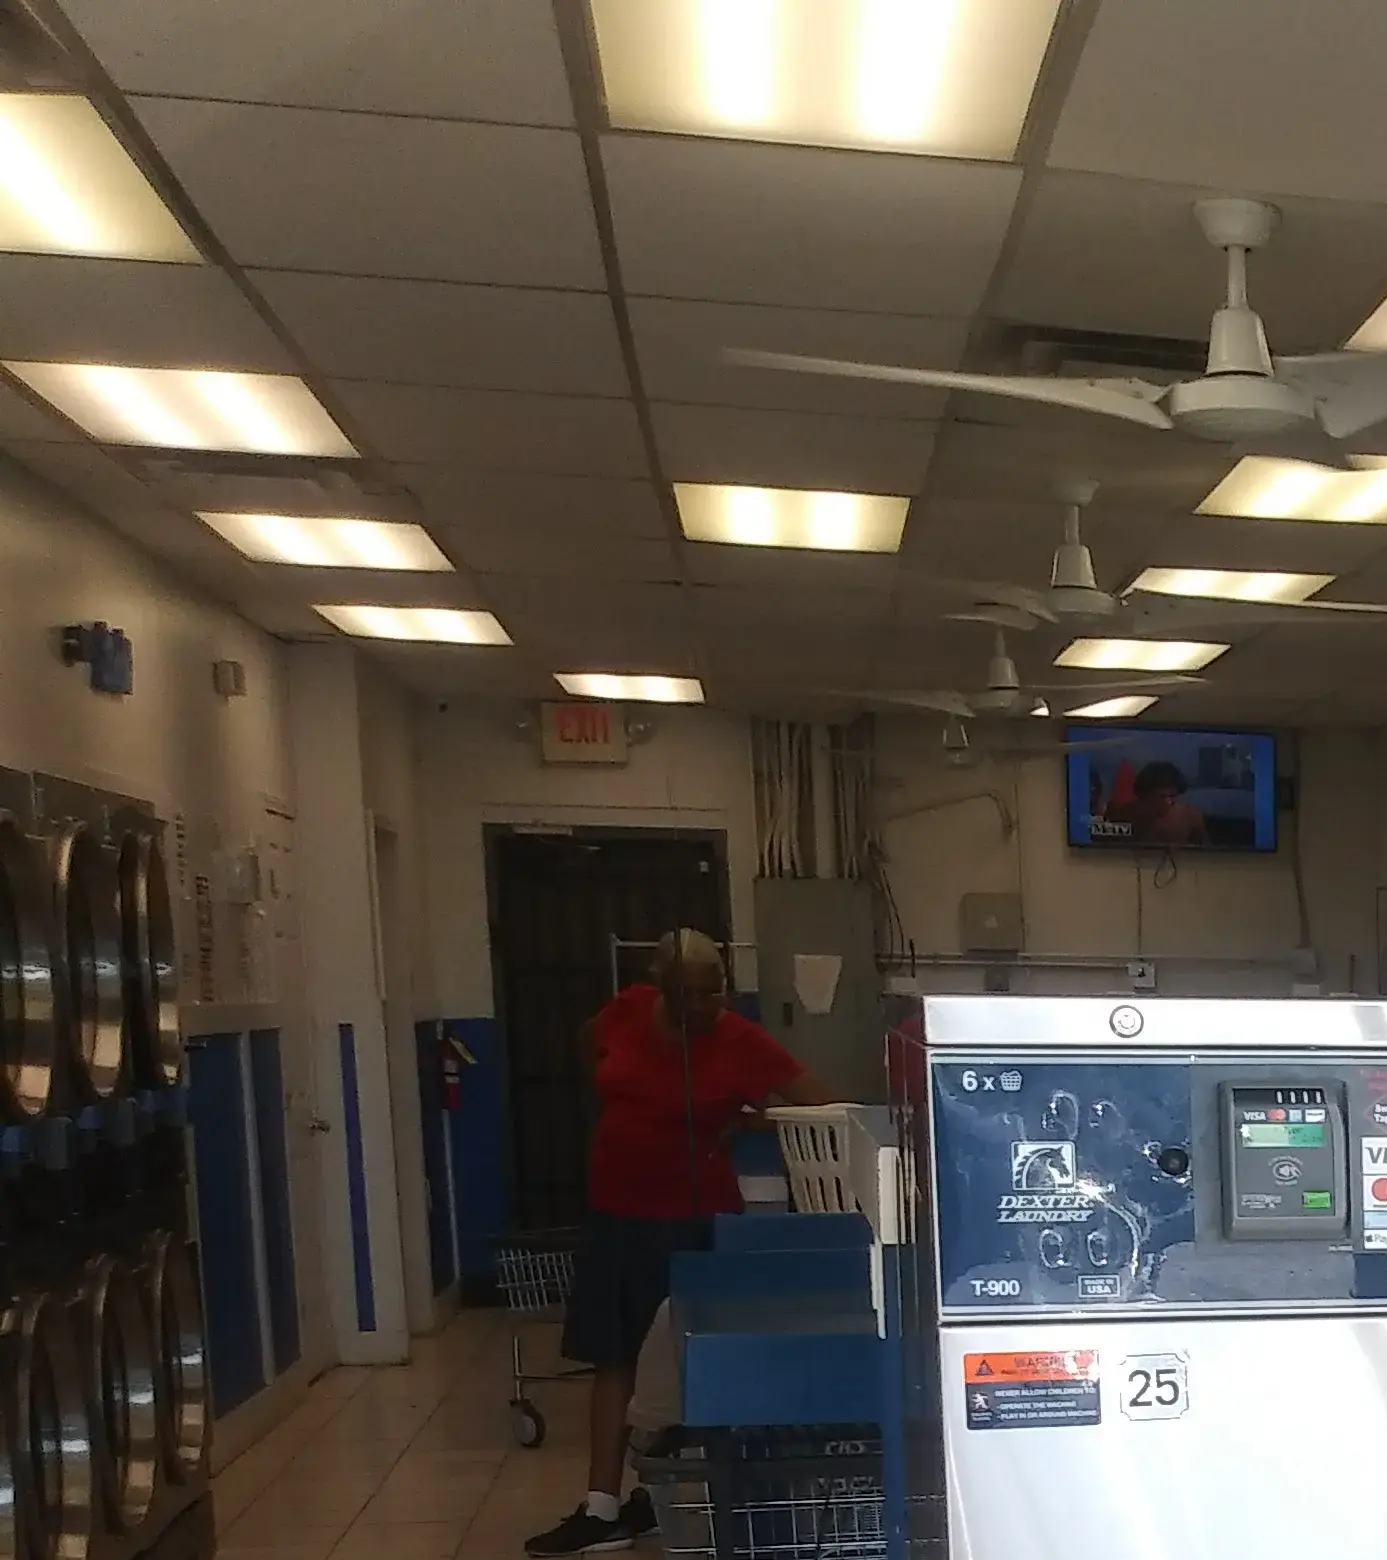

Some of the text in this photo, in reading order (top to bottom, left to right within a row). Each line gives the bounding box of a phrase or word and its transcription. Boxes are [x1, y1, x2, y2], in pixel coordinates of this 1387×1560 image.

[557, 707, 609, 744] EXIT
[962, 1070, 996, 1092] 6 x
[1243, 1111, 1267, 1122] VISA
[997, 1195, 1093, 1209] DEXTER
[997, 1210, 1096, 1223] LAUNDRY
[969, 1279, 1021, 1297] T-900
[1086, 1284, 1113, 1295] USA
[1128, 1368, 1181, 1407] 25
